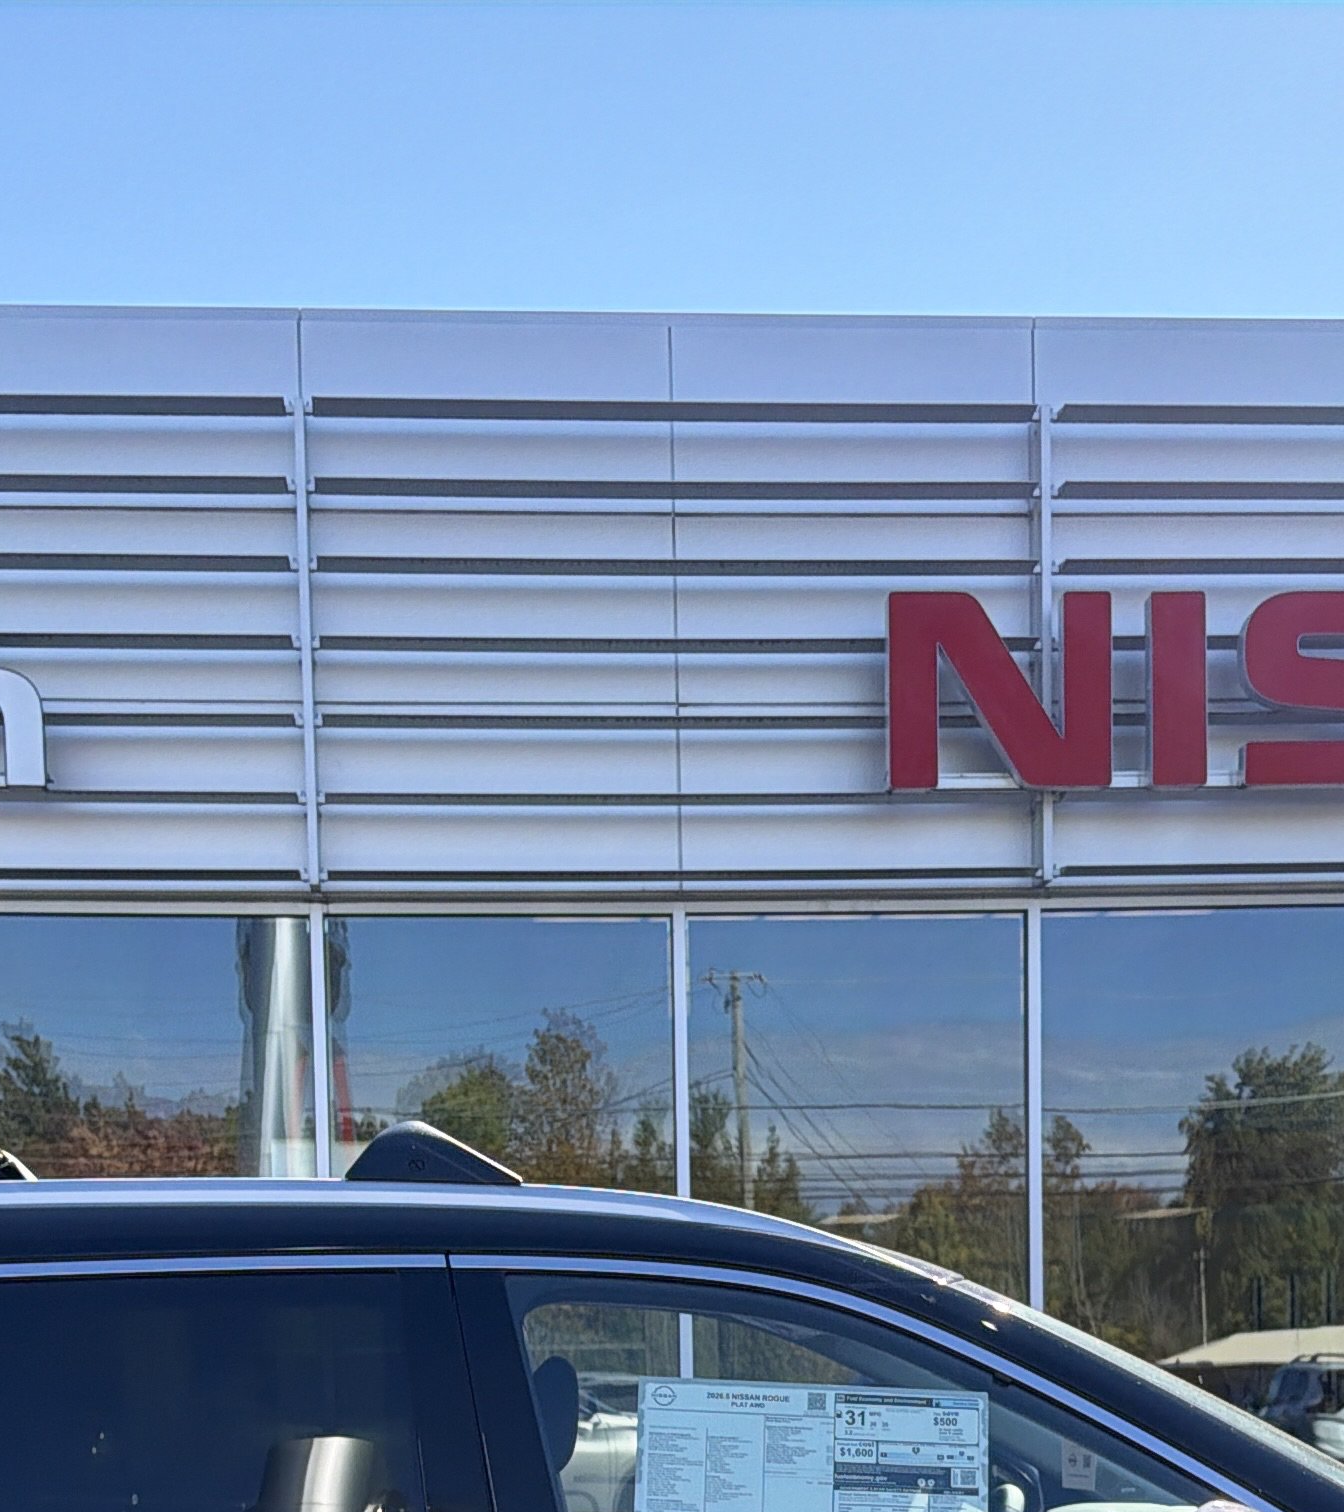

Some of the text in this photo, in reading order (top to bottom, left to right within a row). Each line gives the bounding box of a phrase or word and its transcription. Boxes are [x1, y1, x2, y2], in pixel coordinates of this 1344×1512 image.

[731, 1392, 761, 1402] NISSAN
[762, 1394, 790, 1403] ROGUE
[845, 1409, 865, 1426] 31
[933, 1416, 958, 1427] $500
[839, 1446, 874, 1458] $1,600
